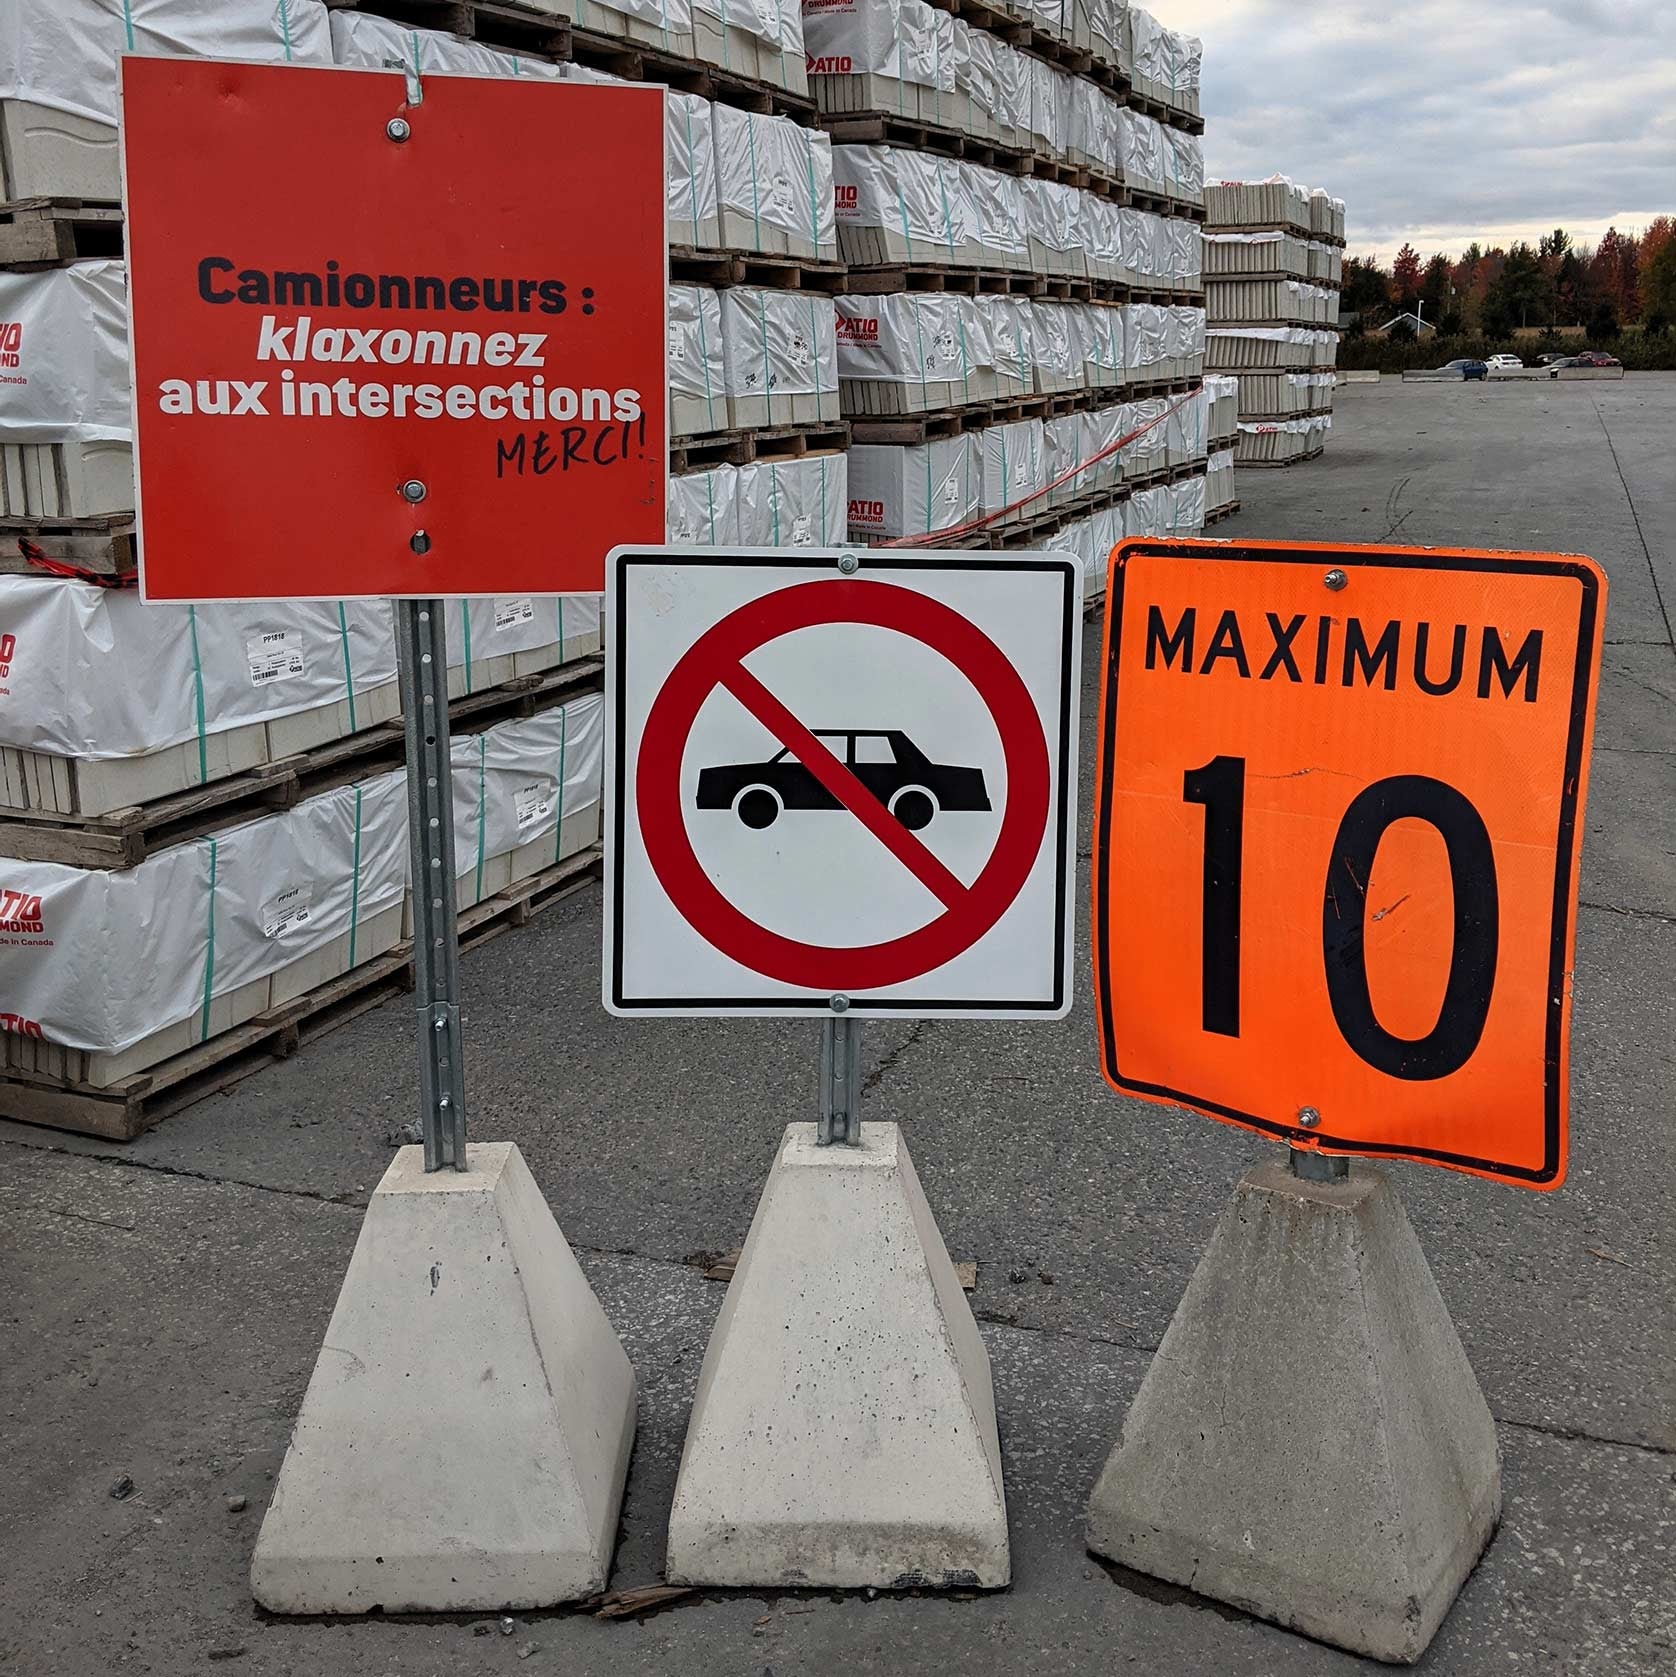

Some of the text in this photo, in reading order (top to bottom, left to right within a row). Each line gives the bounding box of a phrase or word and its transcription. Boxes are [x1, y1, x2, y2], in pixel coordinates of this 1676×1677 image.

[197, 257, 568, 315] Camionneurs
[257, 316, 548, 367] klaxonnez
[158, 369, 641, 422] aux intersections
[497, 411, 646, 478] MERCI!
[1146, 605, 1544, 703] MAXIMUM
[0, 889, 43, 921] TIO
[1183, 755, 1500, 1081] 10
